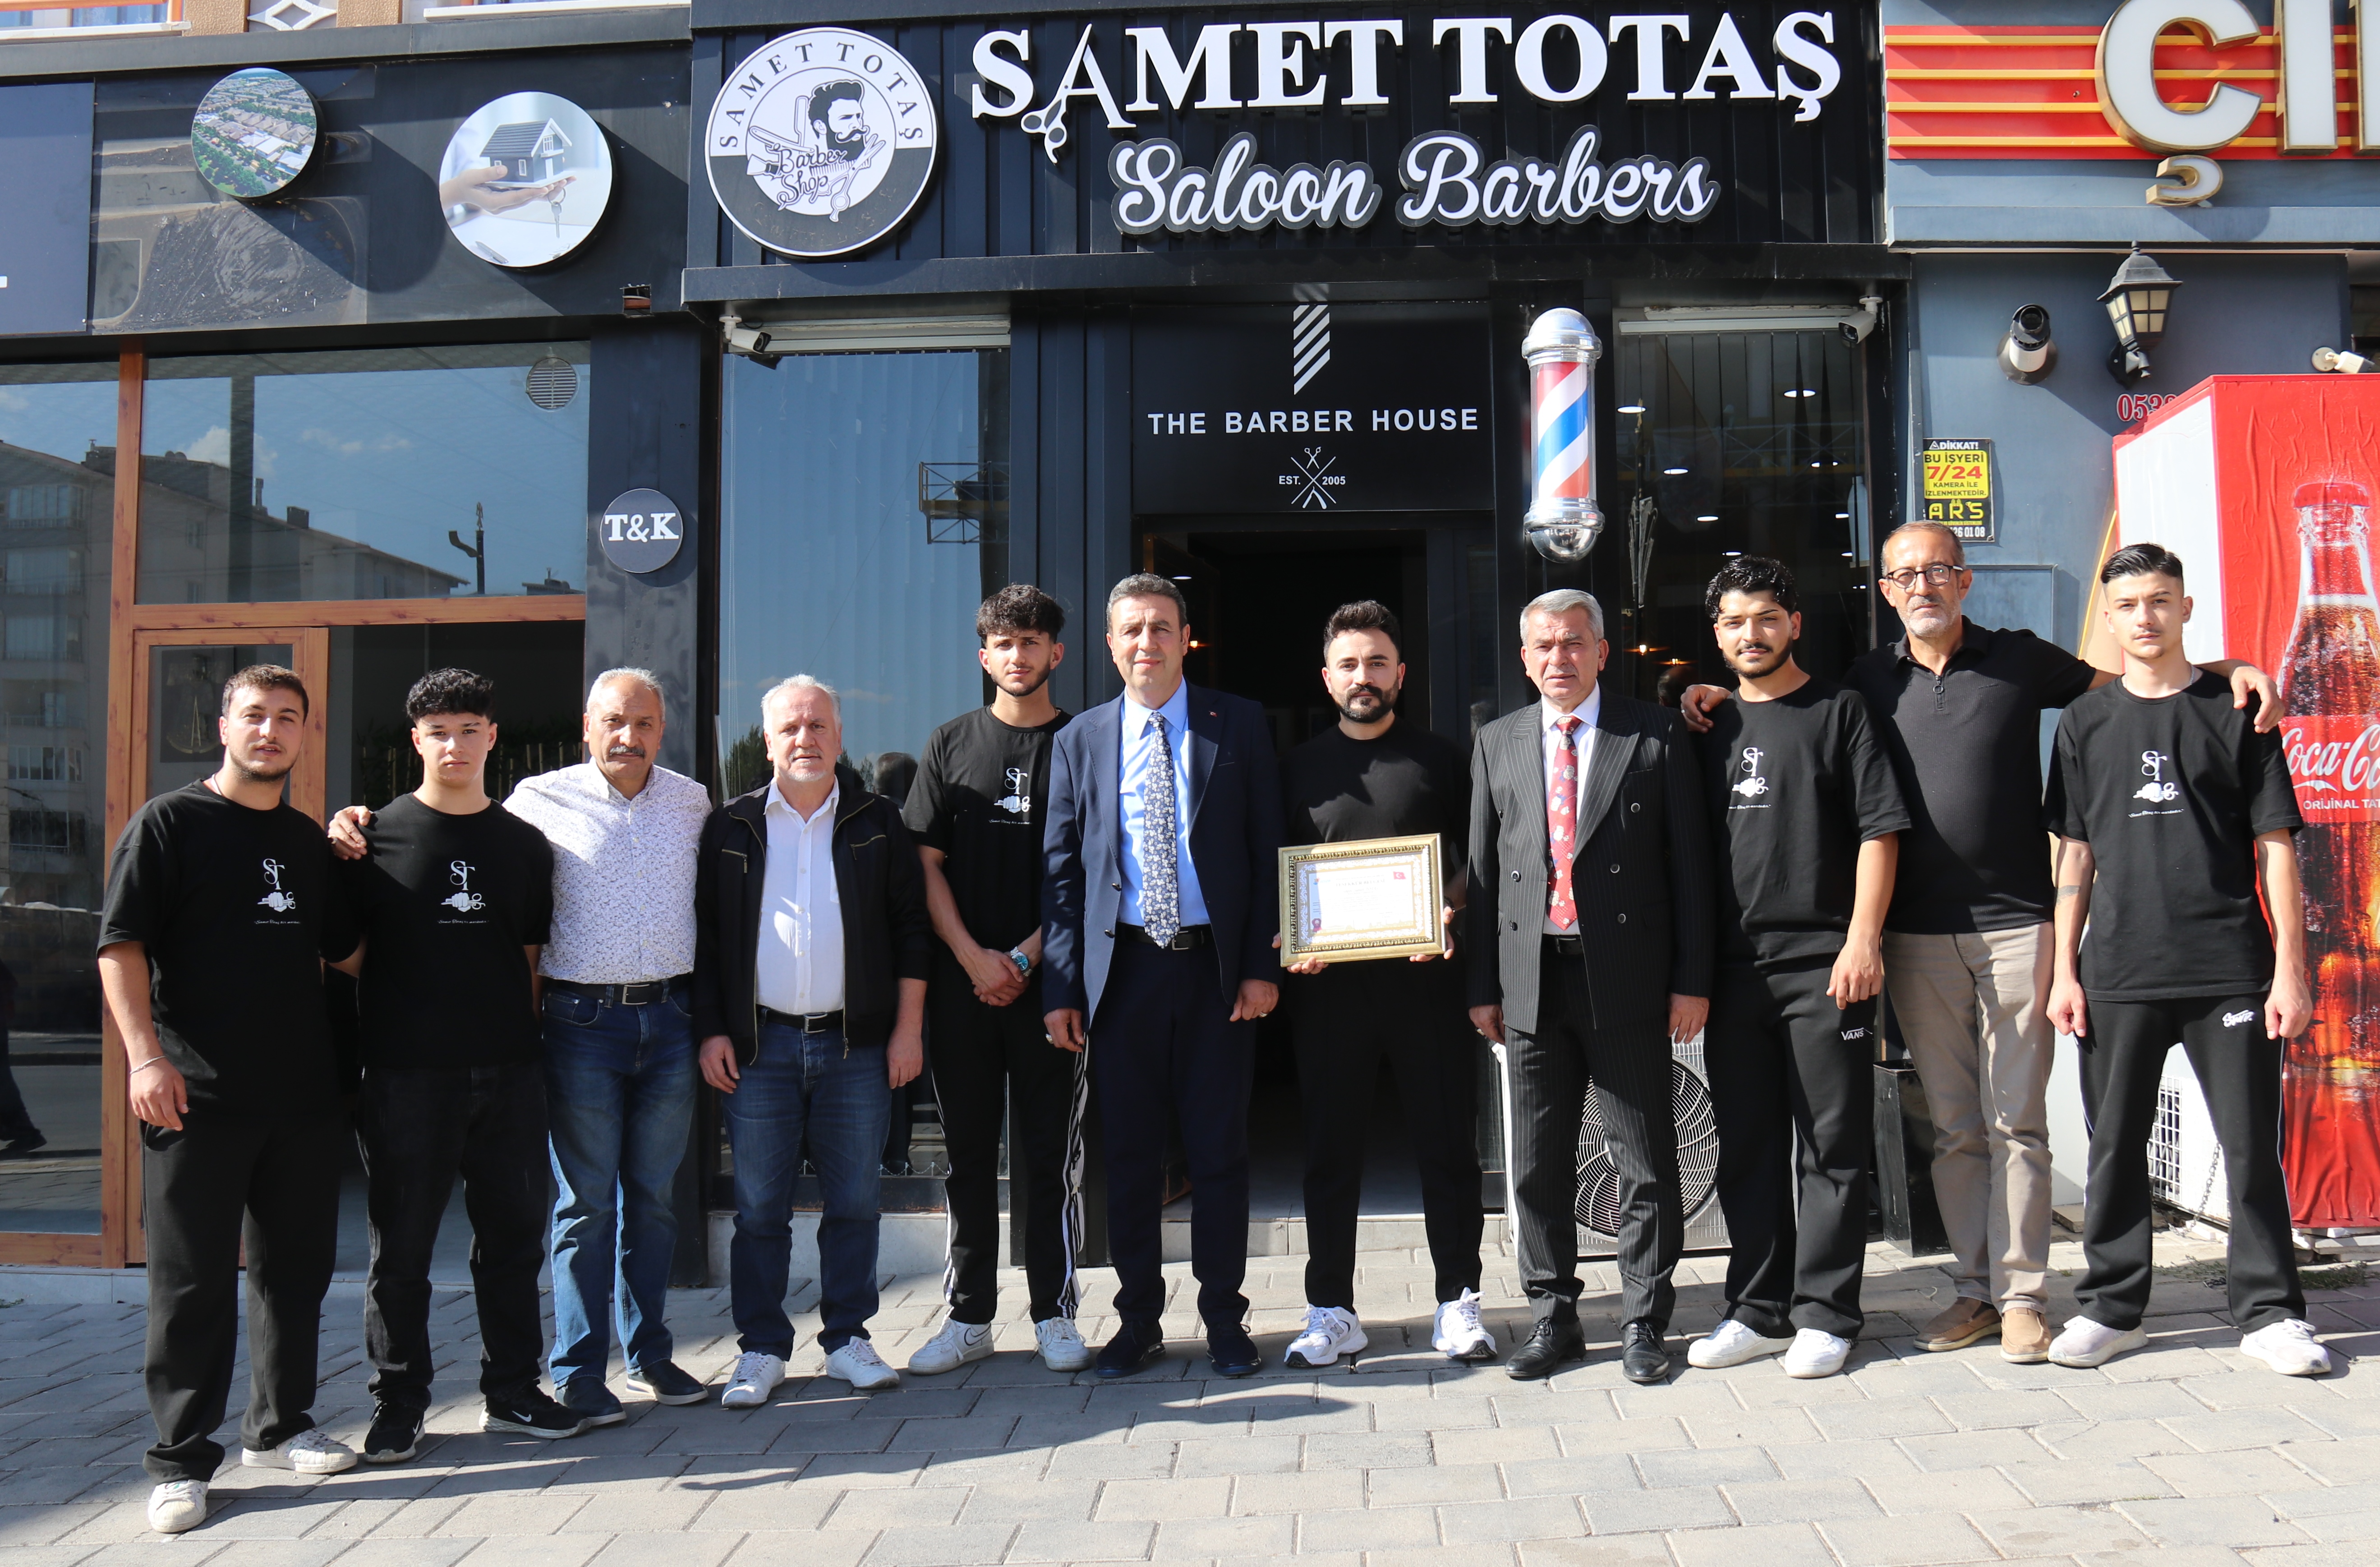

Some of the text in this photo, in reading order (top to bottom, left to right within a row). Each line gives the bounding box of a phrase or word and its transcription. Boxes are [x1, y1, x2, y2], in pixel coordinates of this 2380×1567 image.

[719, 42, 923, 148] SAMET TOTAŞ
[972, 11, 1841, 164] SAMET TOTAŞ
[774, 144, 847, 175] Barber
[1114, 130, 1714, 228] Saloon Barbers
[778, 173, 828, 211] Shop
[1147, 408, 1478, 435] THE BARBER HOUSE
[1939, 440, 1979, 450] DİKKAT!
[1924, 452, 1984, 464] BU İŞYERİ
[1279, 475, 1346, 486] EST. 2005
[1927, 465, 1983, 481] 7/24
[605, 512, 679, 543] T&K
[1964, 526, 1974, 538] 01
[1975, 526, 1986, 538] 08
[2303, 797, 2360, 810] ORİJİNAL
[1841, 1027, 1864, 1041] VANS
